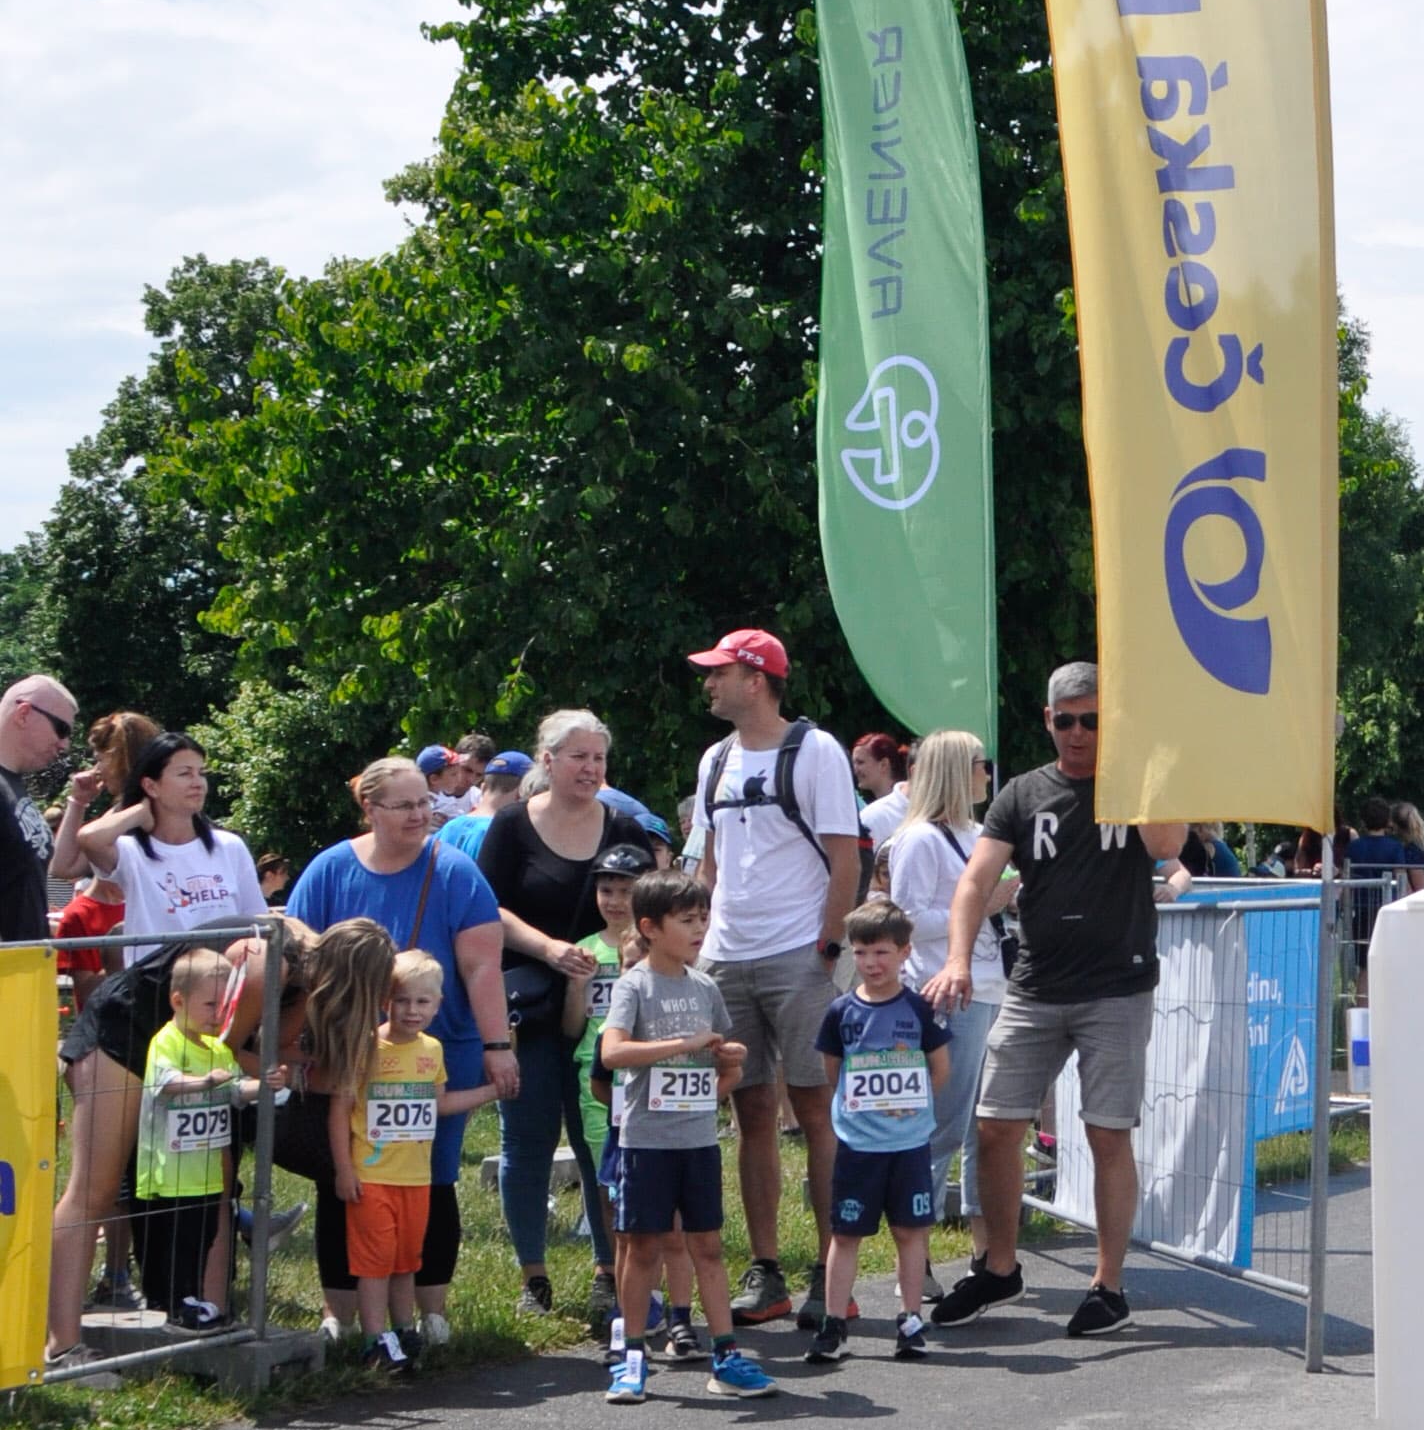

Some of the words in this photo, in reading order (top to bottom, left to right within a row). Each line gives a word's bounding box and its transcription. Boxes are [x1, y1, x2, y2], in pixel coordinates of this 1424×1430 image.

[1033, 811, 1059, 860] R
[189, 889, 229, 905] HELP
[592, 982, 613, 1005] 21
[660, 998, 687, 1014] WHO
[688, 997, 699, 1011] IS
[660, 1071, 711, 1097] 2136
[853, 1071, 921, 1098] 2004
[177, 1109, 228, 1138] 2079
[376, 1102, 433, 1127] 2076
[912, 1191, 931, 1217] 09
